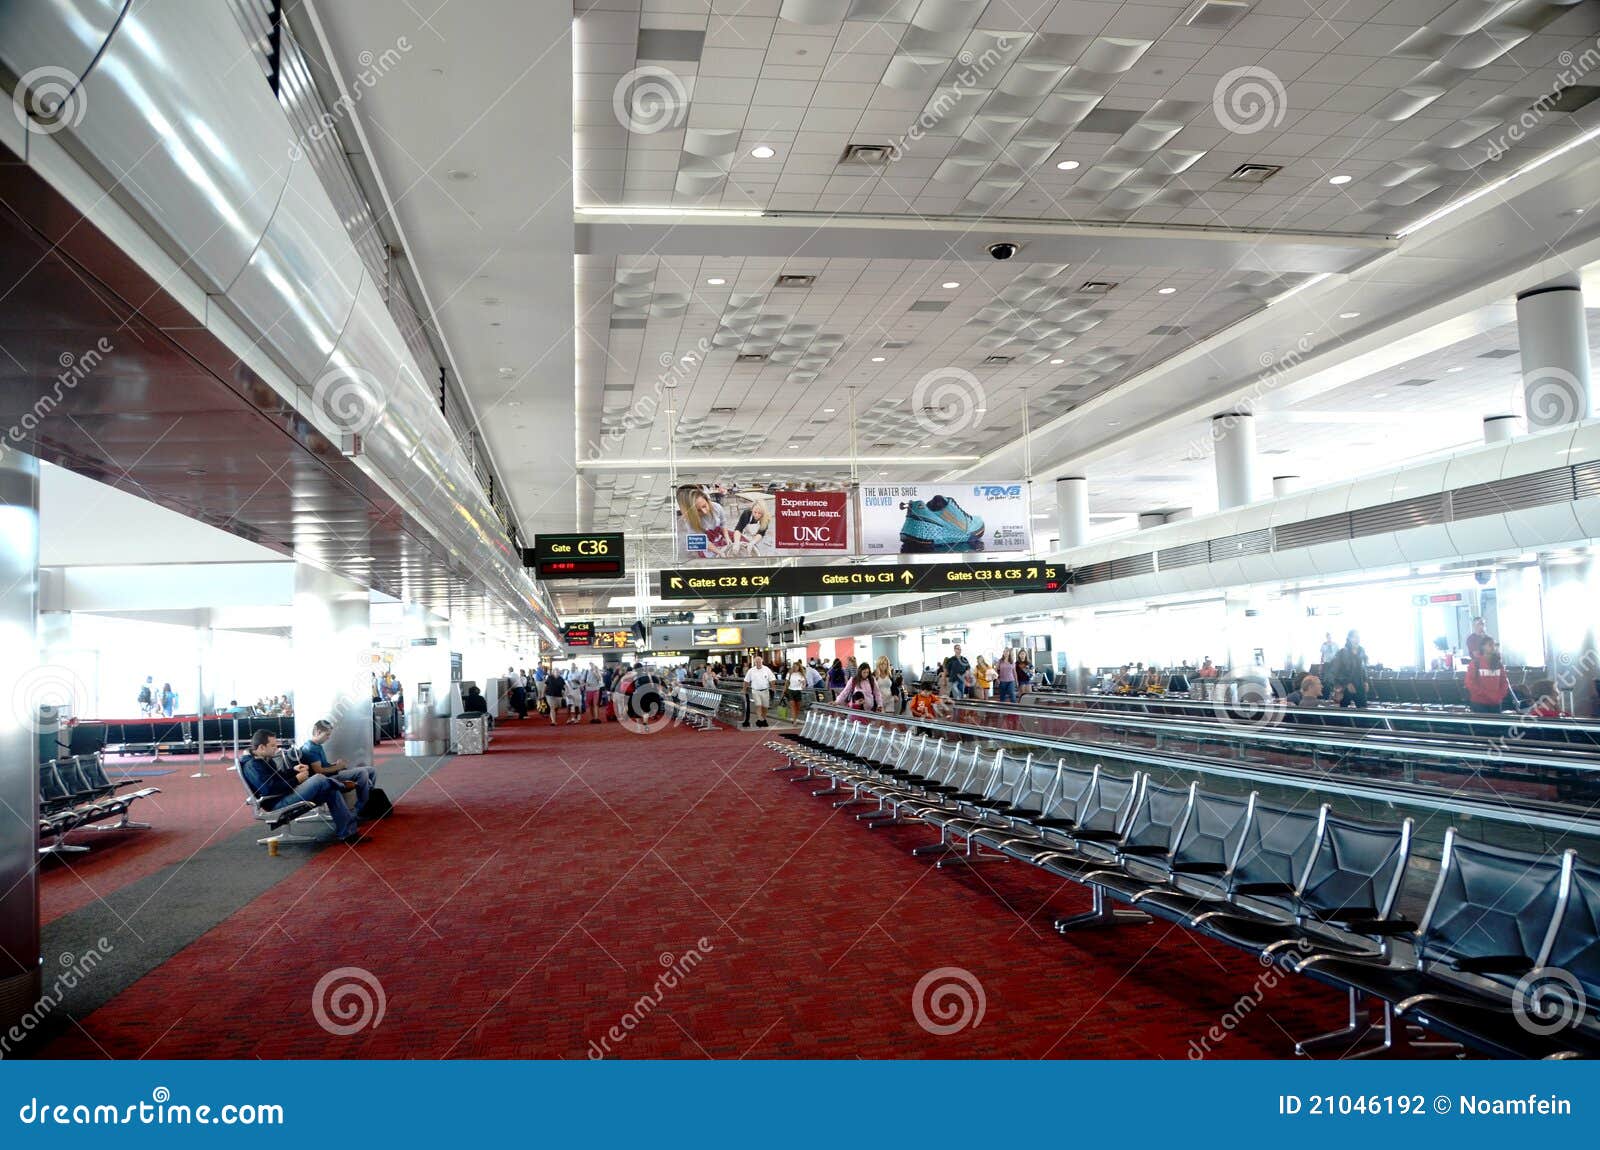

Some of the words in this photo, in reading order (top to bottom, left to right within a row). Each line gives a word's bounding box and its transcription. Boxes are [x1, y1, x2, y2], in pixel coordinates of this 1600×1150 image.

[864, 487, 876, 497] THE
[878, 487, 900, 497] WATER
[901, 487, 918, 497] SHOE
[781, 498, 828, 508] Experience
[865, 496, 892, 506] EVOLVED
[781, 509, 801, 517] what
[801, 510, 817, 518] you
[817, 510, 841, 518] learn.
[792, 526, 831, 541] UNC
[551, 544, 571, 553] Gate
[577, 540, 608, 555] C36
[822, 574, 849, 584] Gates
[851, 573, 862, 583] C1
[865, 574, 875, 583] to
[878, 573, 894, 583] C31
[947, 571, 973, 581] Gates
[975, 570, 992, 580] C33
[995, 570, 1003, 579] &
[1005, 569, 1022, 579] C35
[688, 578, 716, 588] Gates
[718, 577, 737, 587] C32
[740, 577, 749, 586] &
[751, 576, 770, 586] C34
